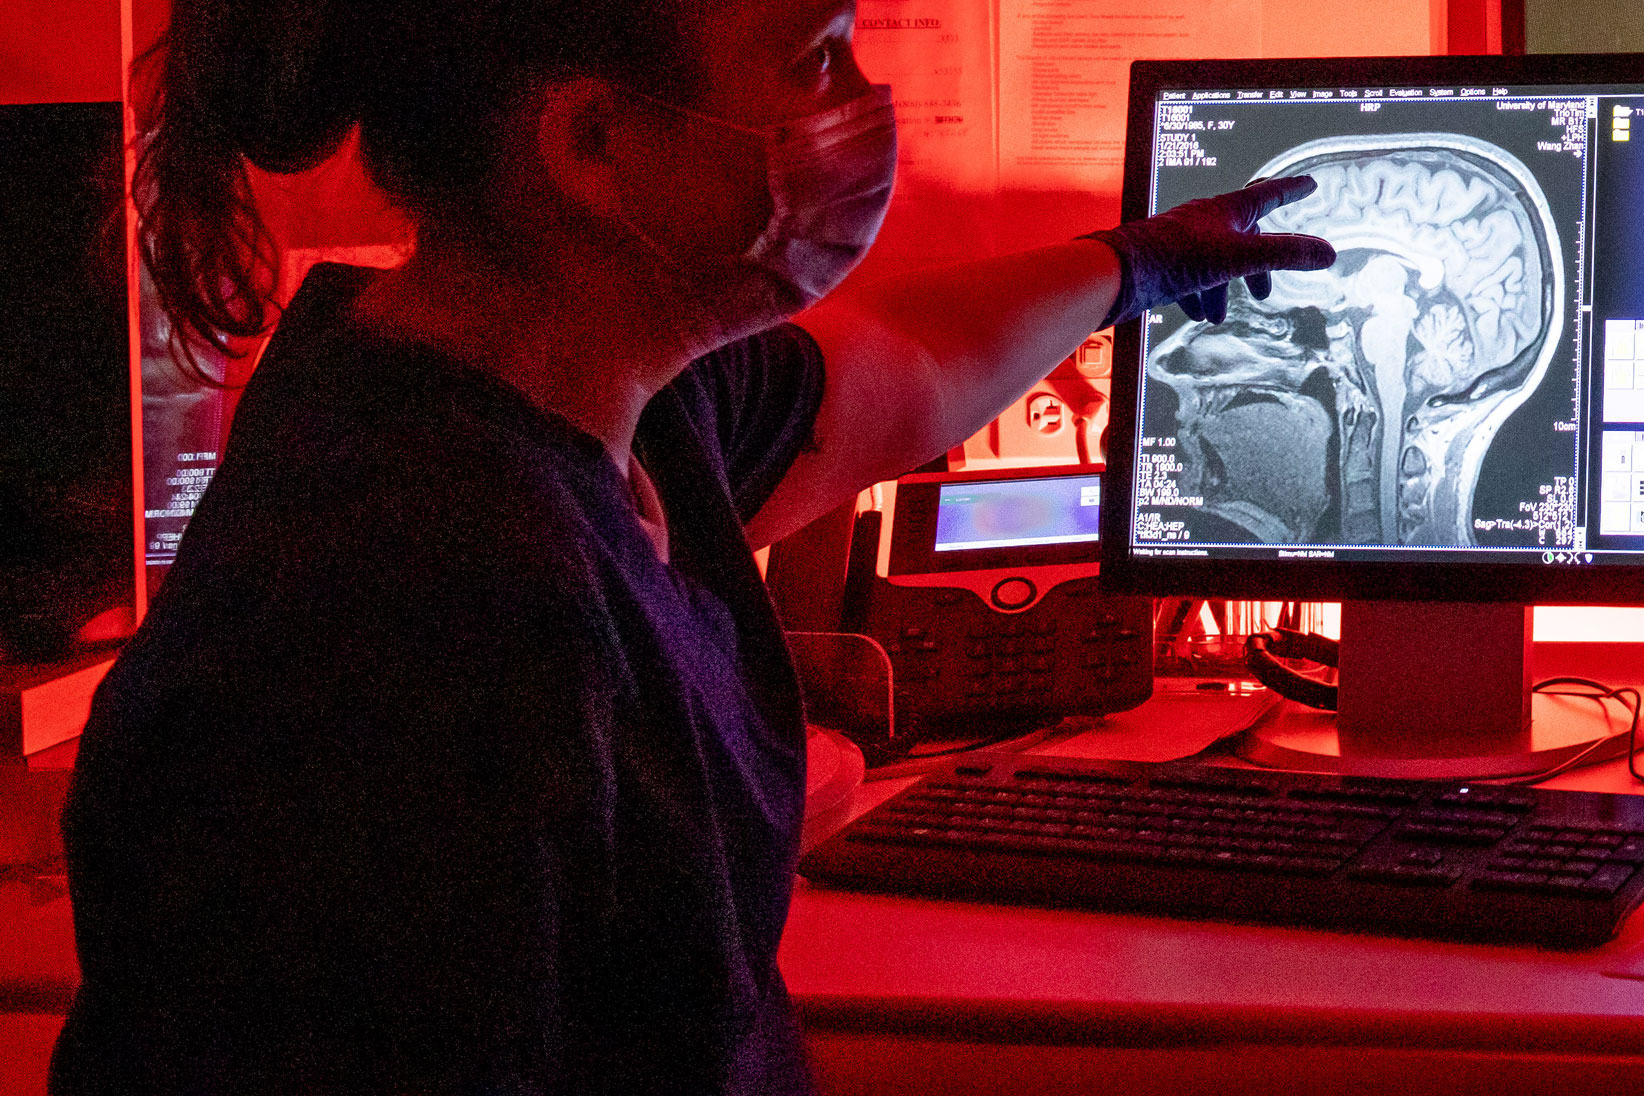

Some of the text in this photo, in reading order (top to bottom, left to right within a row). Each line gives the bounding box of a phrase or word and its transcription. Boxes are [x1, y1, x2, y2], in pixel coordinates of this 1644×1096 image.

[1163, 88, 1508, 100] Patient Applications Transfer Edit View Image Tools Scroll Evaluation System Options Help
[1360, 103, 1382, 112] HRP
[1496, 100, 1585, 111] University of Maryland
[1554, 108, 1584, 117] TrioTim
[1218, 121, 1235, 130] 30Y
[1552, 116, 1566, 126] MR
[1566, 124, 1584, 134] HFS
[1160, 134, 1190, 142] STUDY
[1537, 142, 1584, 152] Wang Zhan
[1190, 149, 1204, 157] PM
[1158, 438, 1176, 446] 1.00
[1554, 476, 1567, 486] TP
[1539, 485, 1552, 494] SP
[1519, 502, 1537, 512] FoV
[1133, 548, 1154, 556] Waiting
